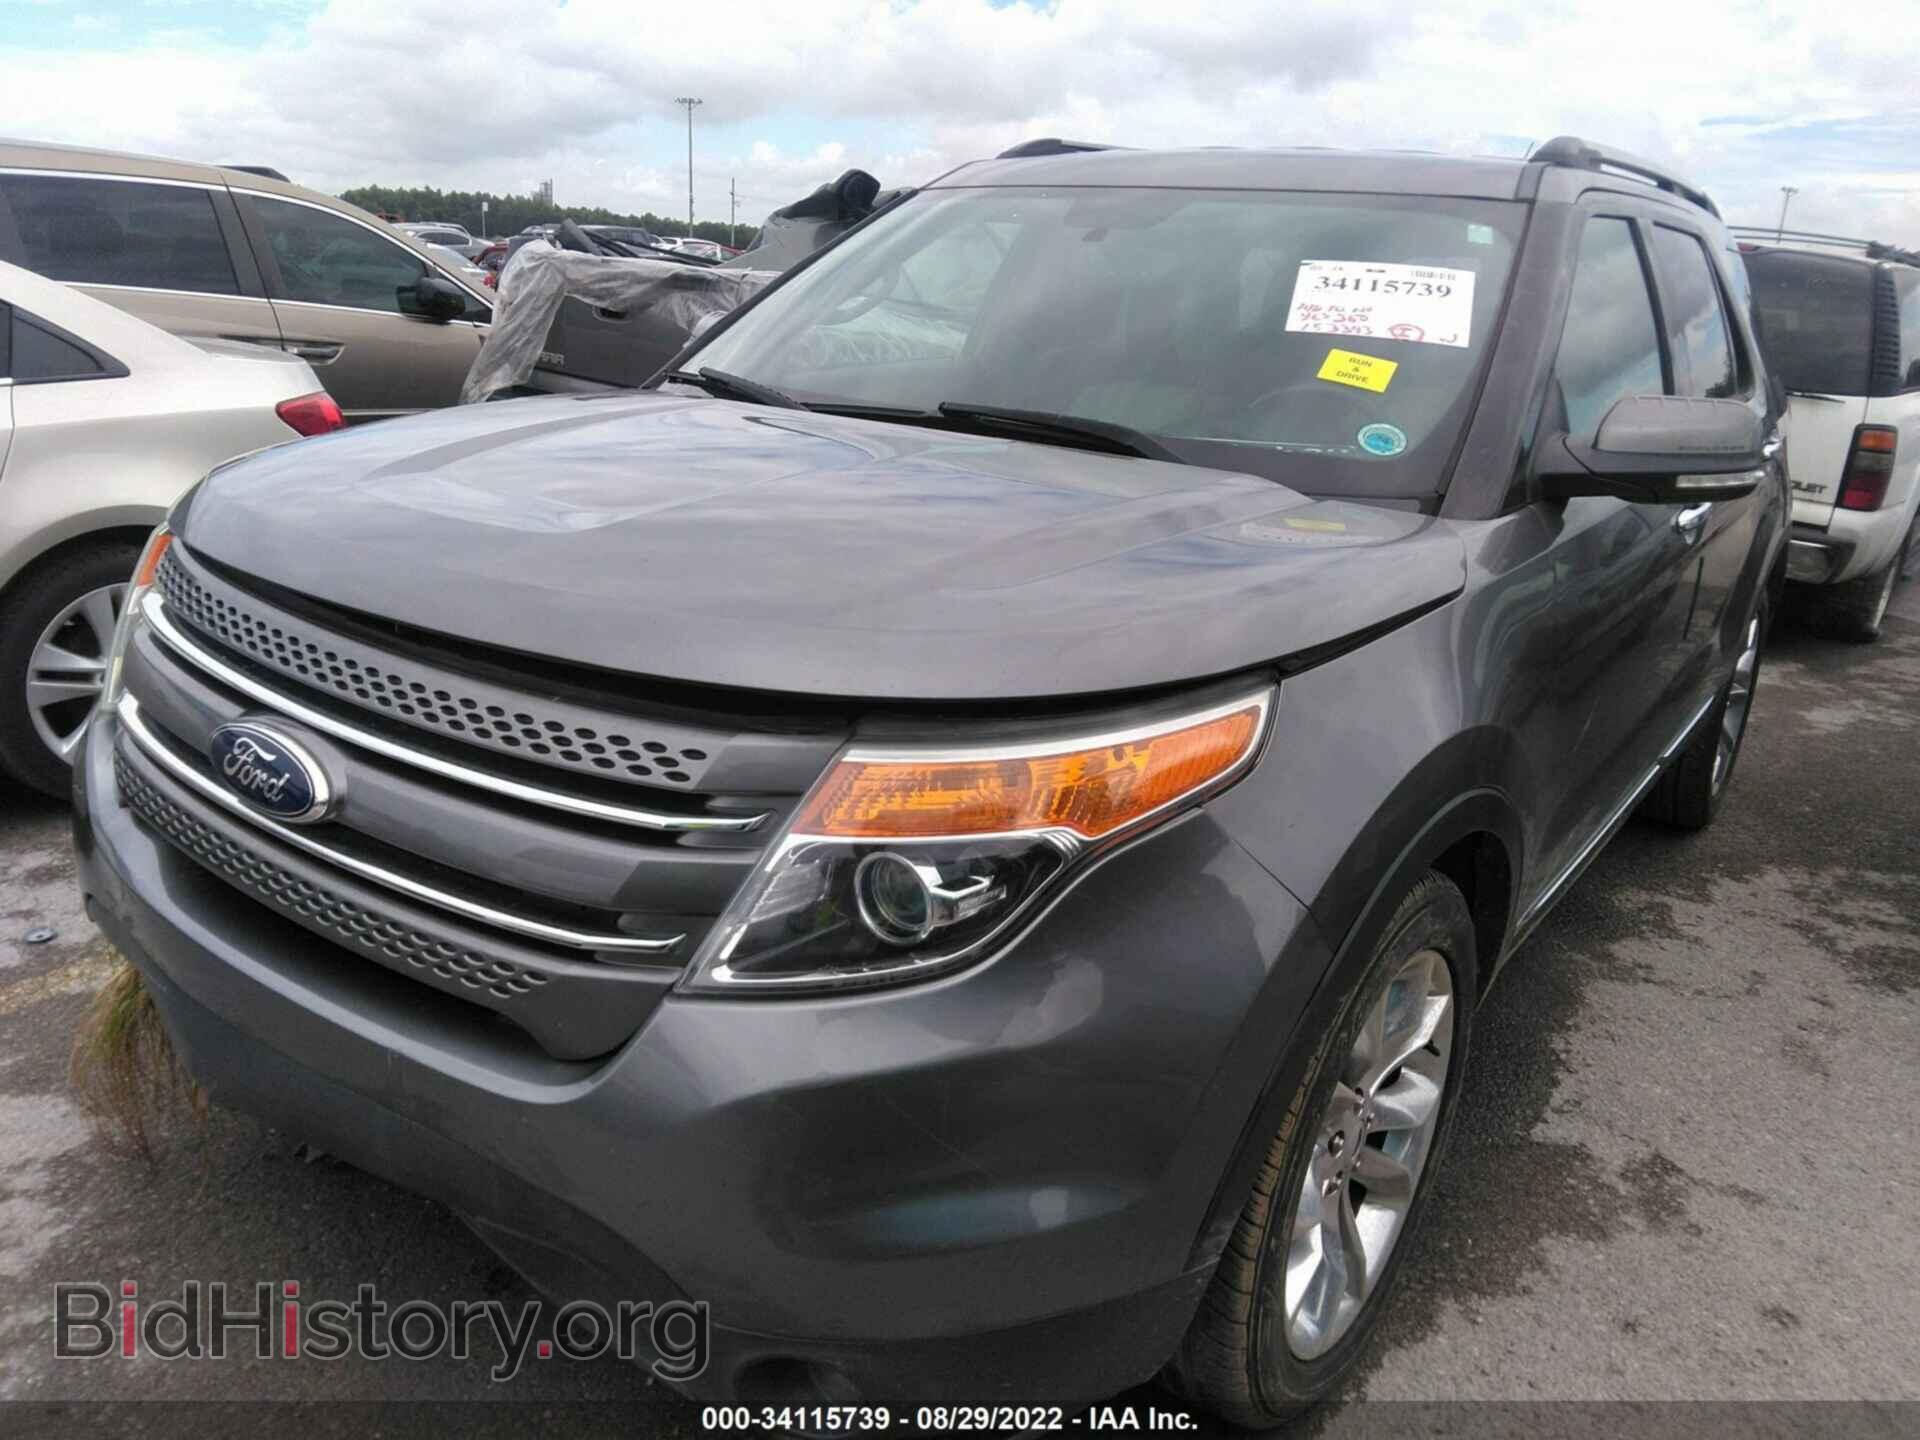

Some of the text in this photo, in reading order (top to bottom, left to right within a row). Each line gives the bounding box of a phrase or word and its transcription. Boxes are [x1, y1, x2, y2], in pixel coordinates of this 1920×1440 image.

[1314, 275, 1452, 298] 34115739
[1348, 357, 1373, 368] RUN
[1335, 370, 1369, 384] DRIVE
[222, 736, 291, 802] Ford
